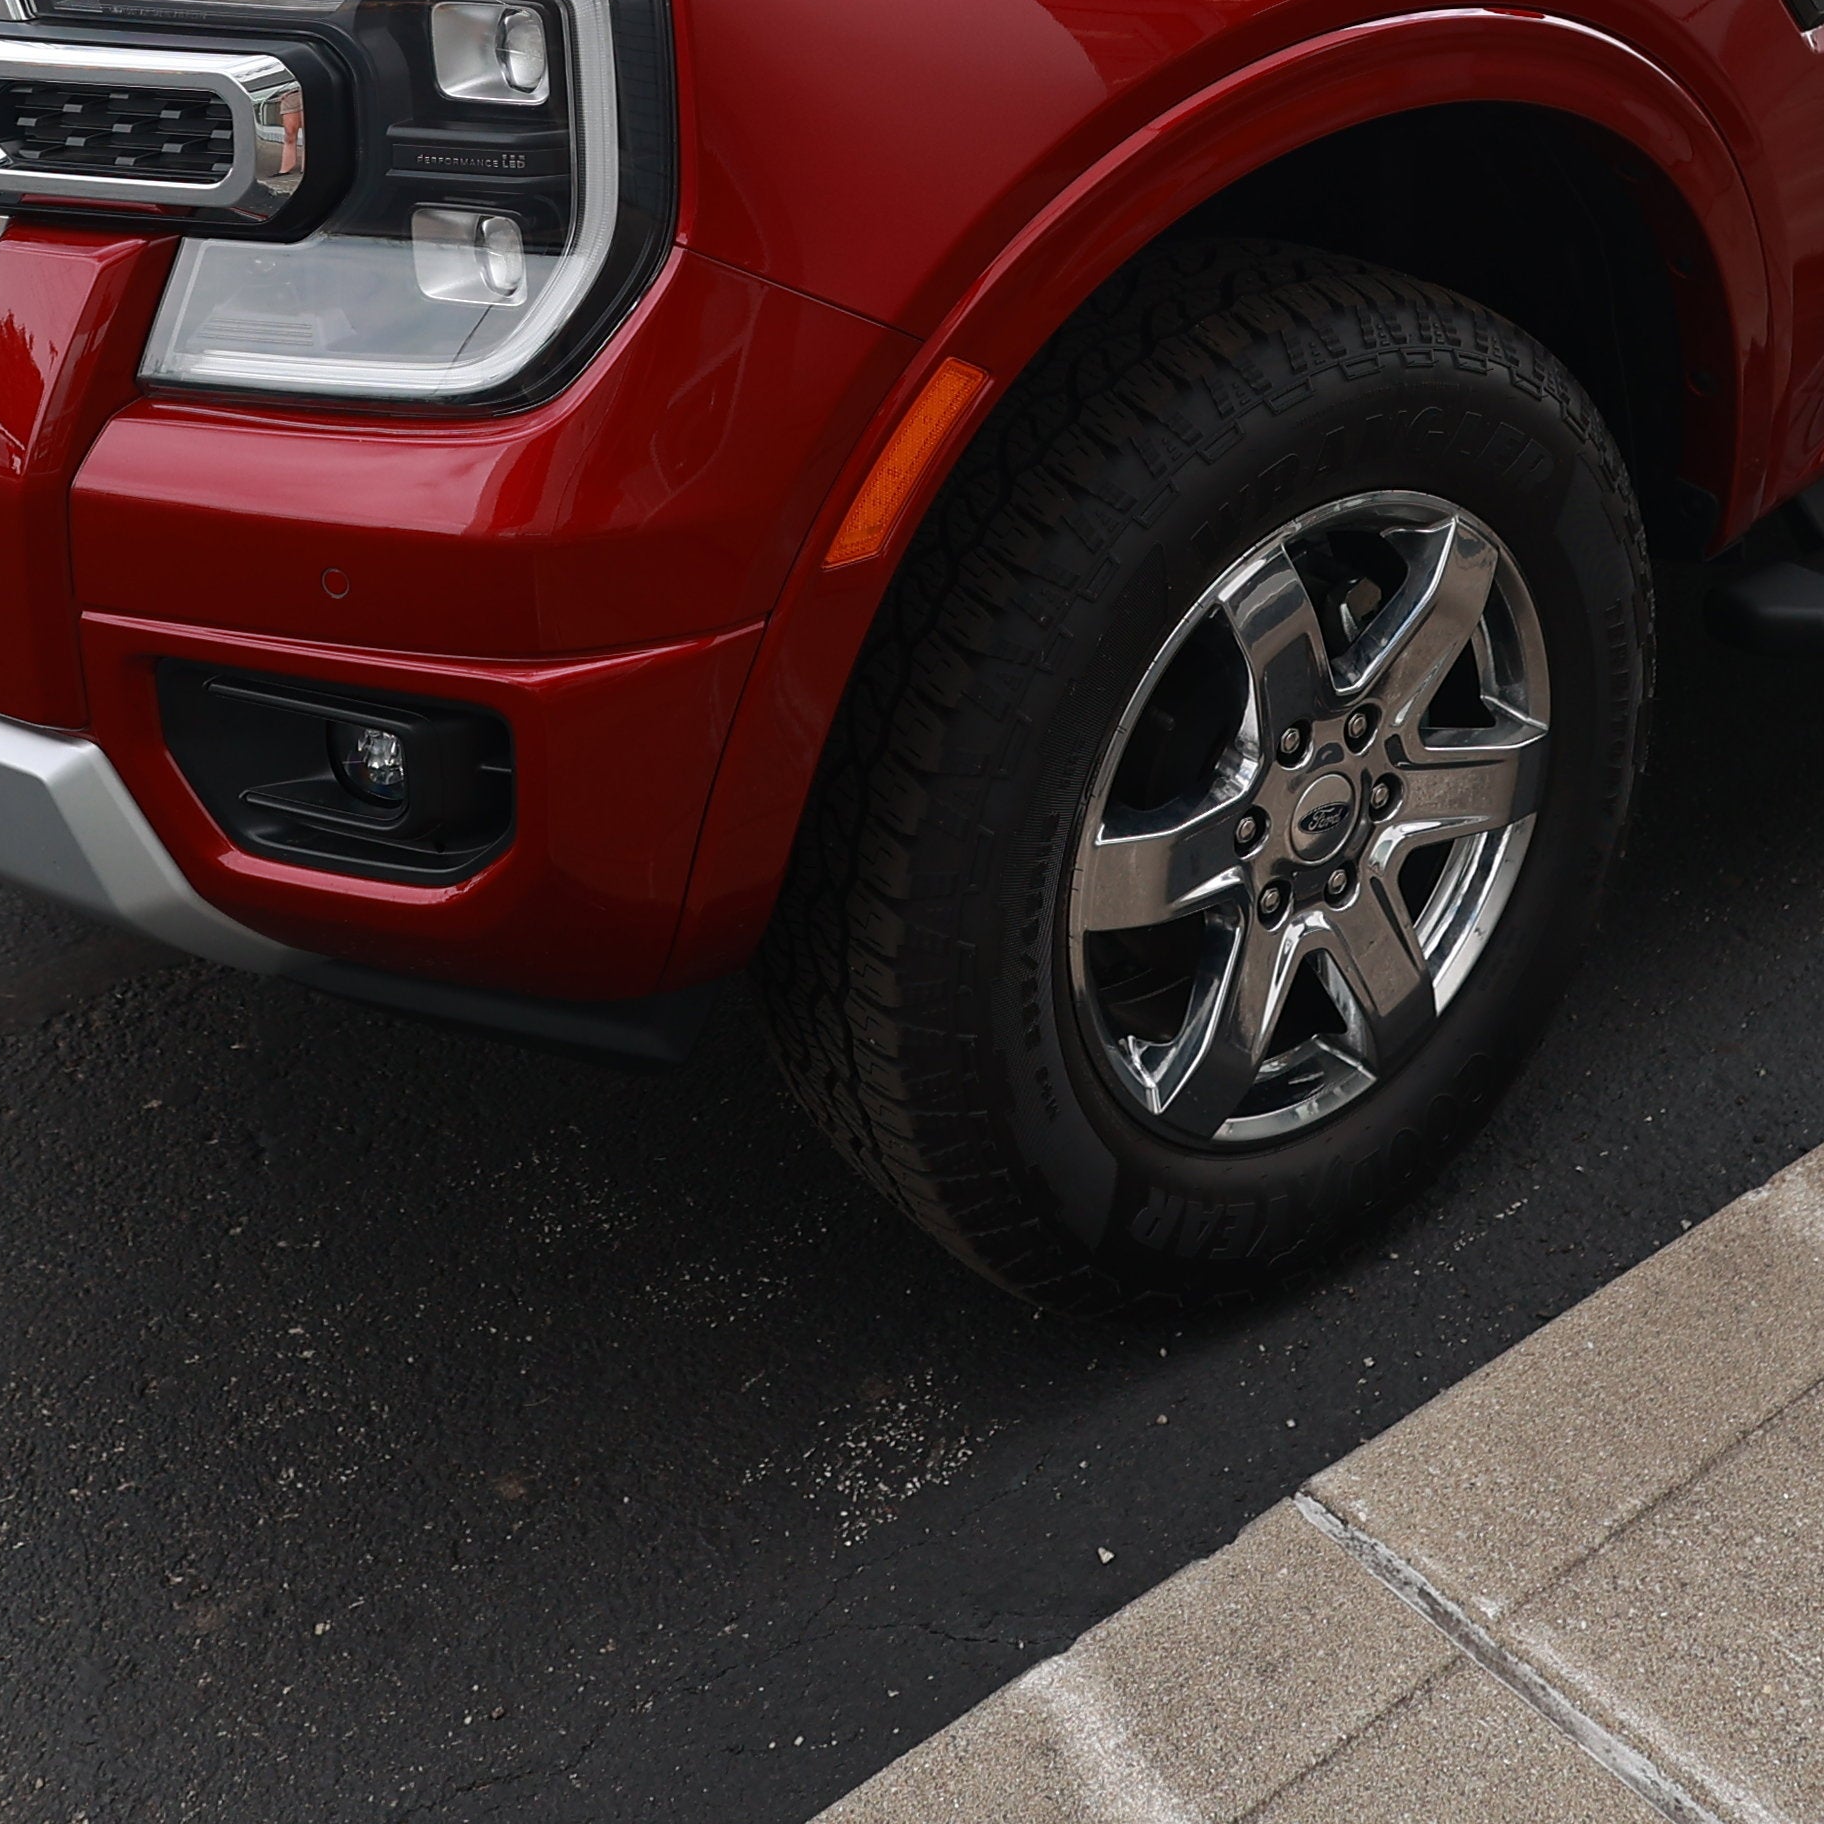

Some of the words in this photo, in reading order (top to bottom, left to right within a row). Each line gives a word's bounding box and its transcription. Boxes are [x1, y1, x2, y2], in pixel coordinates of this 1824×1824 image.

[417, 156, 499, 168] PERFORMANCE
[1188, 405, 1552, 552] WRANGLER
[1308, 806, 1344, 831] Ford
